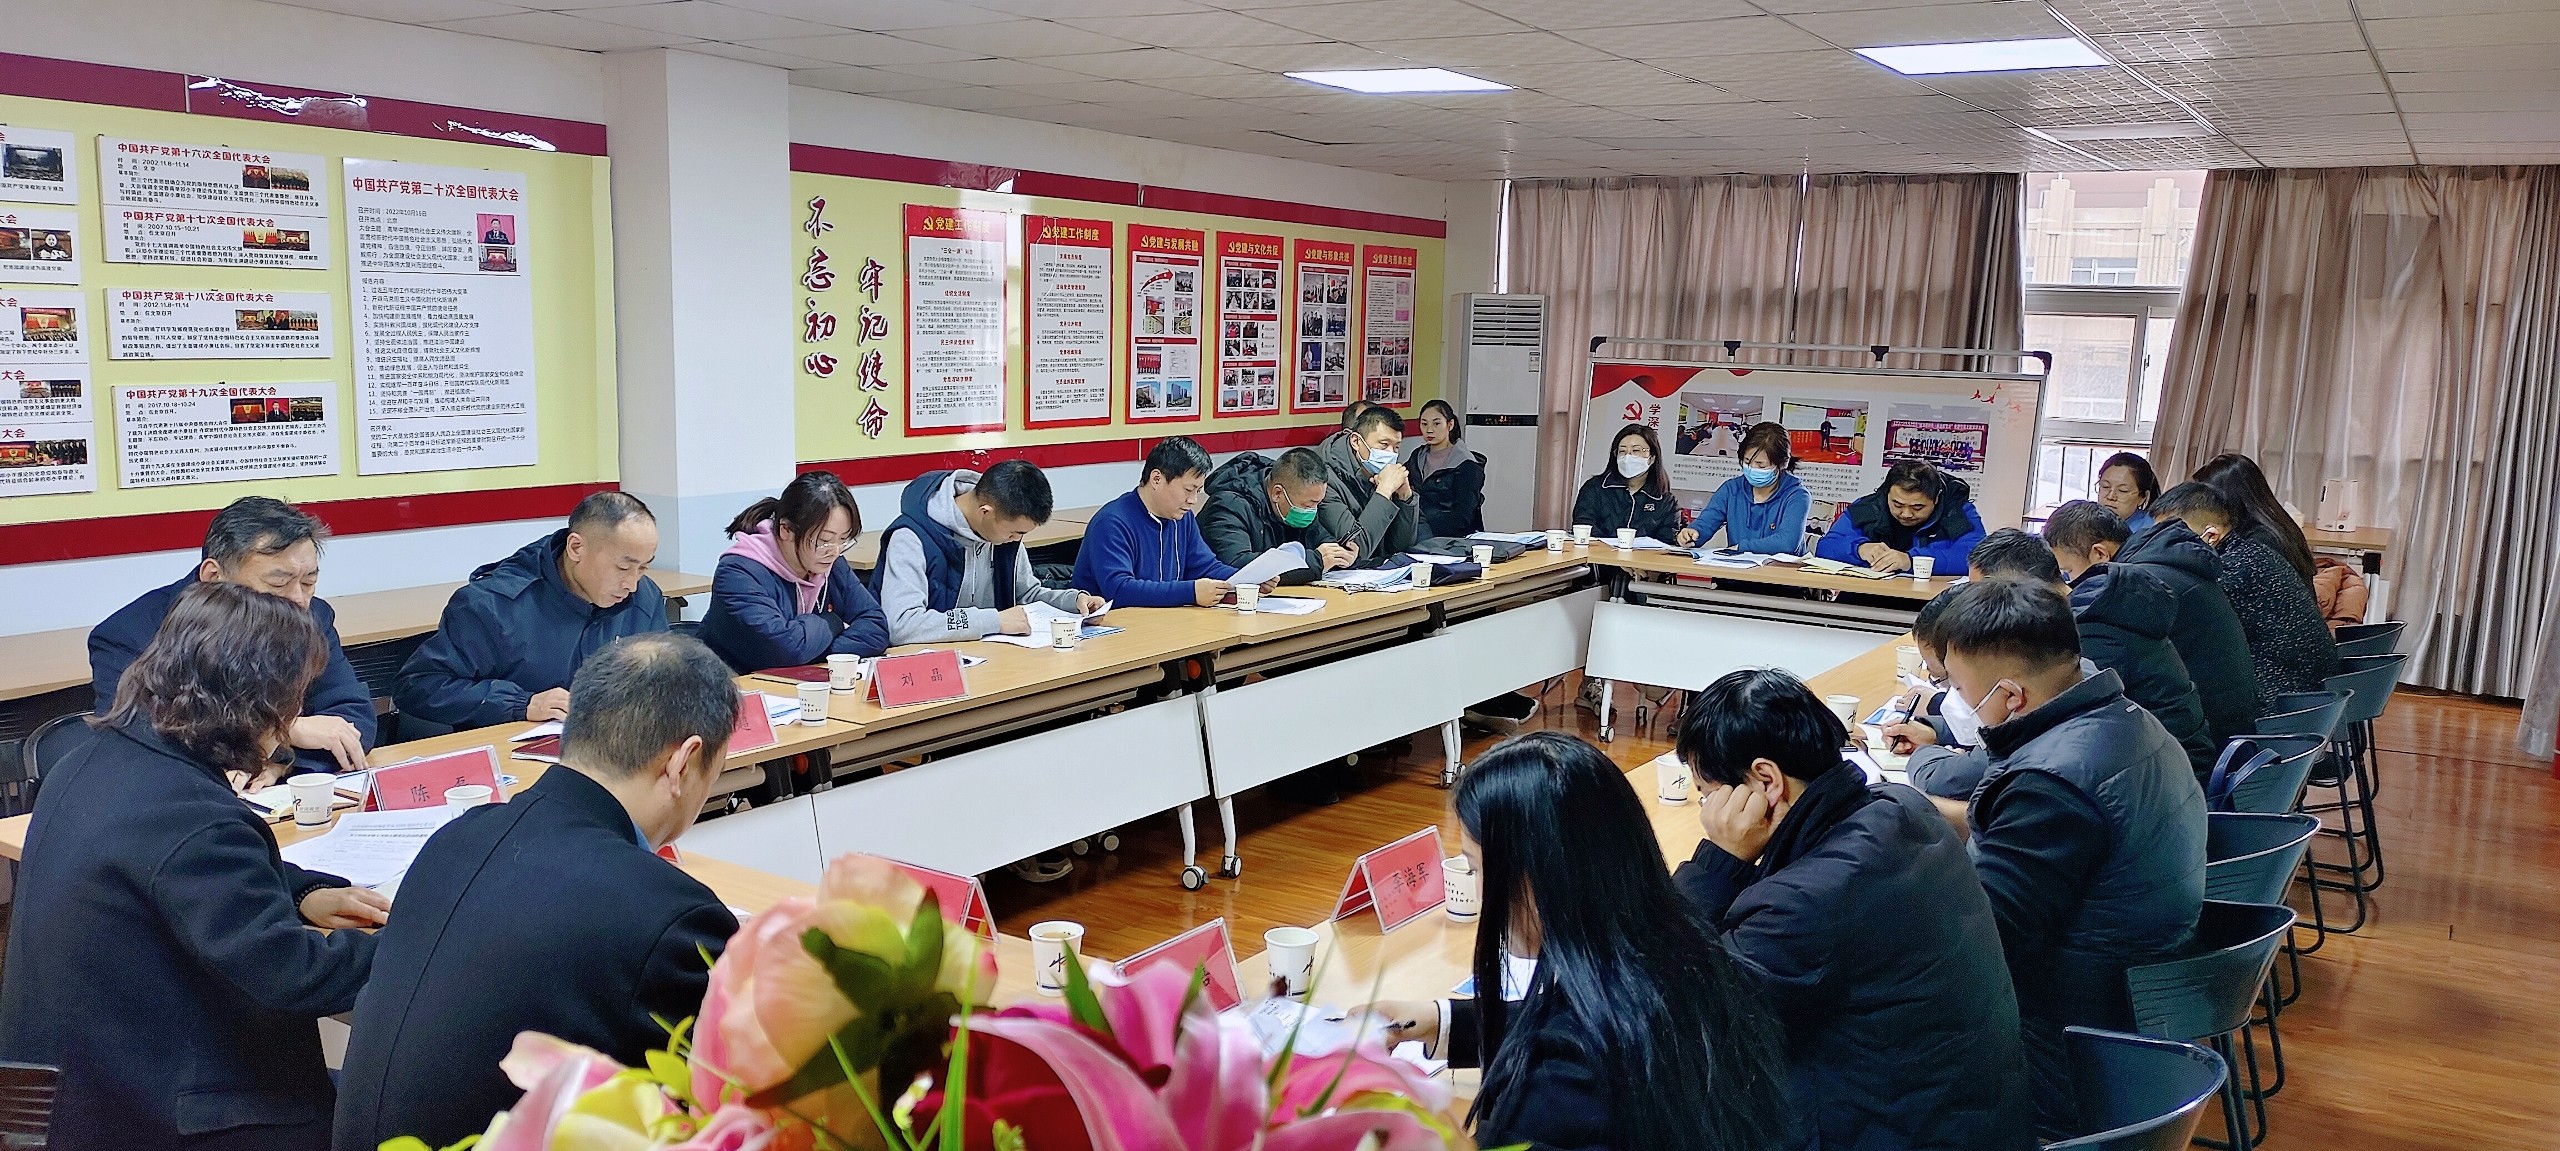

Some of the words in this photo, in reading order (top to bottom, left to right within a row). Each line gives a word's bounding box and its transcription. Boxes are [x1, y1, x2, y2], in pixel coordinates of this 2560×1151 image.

[117, 142, 271, 164] 中国共产党第十六次全国代表大会
[352, 177, 519, 202] 中国共产党第二十次全国代表大会
[122, 211, 275, 228] 中国共产党第十七次全国代表大会
[1051, 225, 1100, 241] 党建工作制度
[803, 196, 838, 378] 不忘初心
[122, 290, 274, 303] 中国共产党第十八次全国代表大会
[857, 256, 890, 440] 牢记使命
[126, 386, 277, 399] 中国共产党第十九次全国代表大会
[901, 672, 914, 687] 刘
[410, 784, 431, 803] 陈
